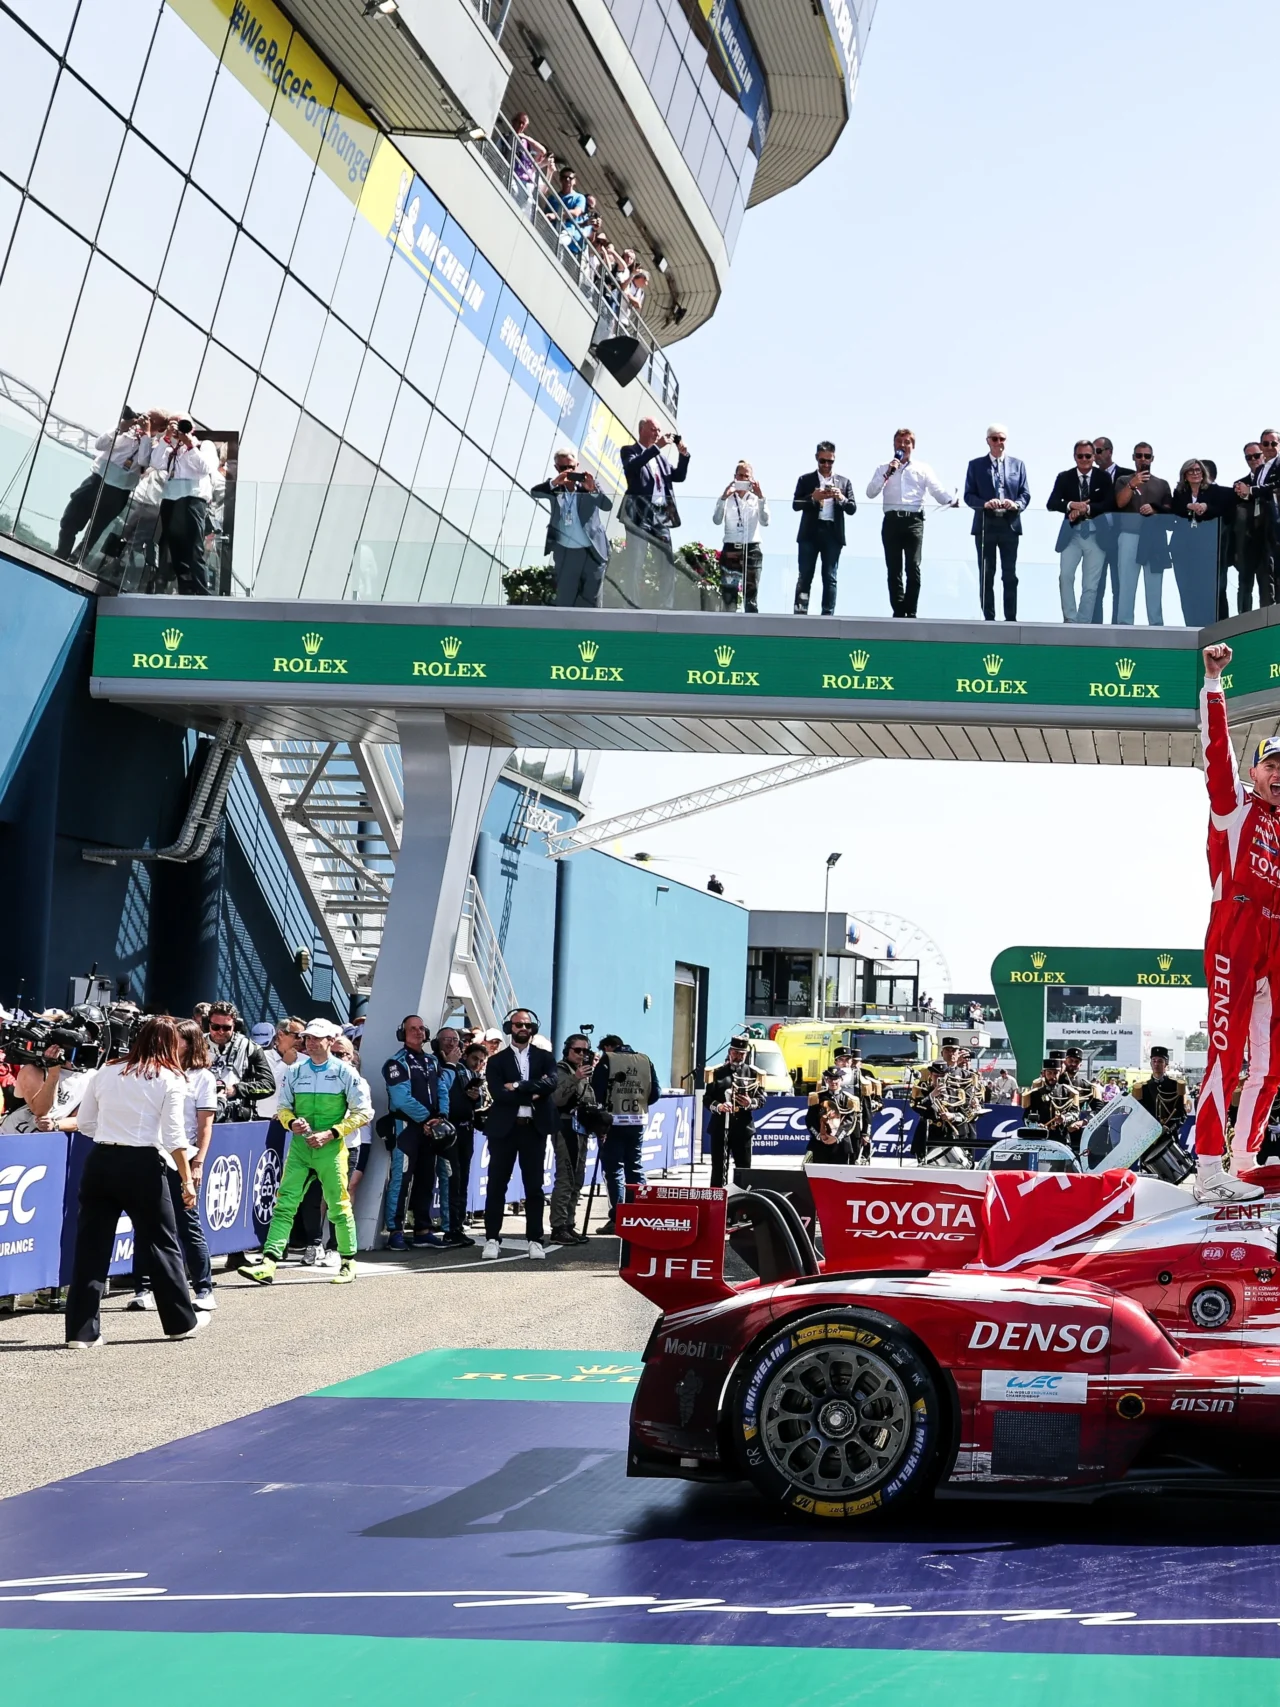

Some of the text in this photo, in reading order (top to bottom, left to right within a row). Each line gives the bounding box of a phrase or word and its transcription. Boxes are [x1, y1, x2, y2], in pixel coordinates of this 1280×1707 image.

[721, 16, 753, 93] MICHELIN
[230, 0, 370, 182] #WeRaceForChange
[417, 224, 485, 312] MICHELIN
[500, 315, 576, 418] #WeRaceForChange
[132, 653, 208, 670] ROLEX
[273, 657, 348, 674] ROLEX
[412, 661, 487, 678] ROLEX
[550, 665, 624, 682] ROLEX
[687, 670, 760, 687] ROLEX
[822, 674, 894, 691] ROLEX
[956, 678, 1028, 695] ROLEX
[1089, 682, 1160, 699] ROLEX
[1010, 971, 1066, 984] ROLEX
[1137, 973, 1192, 986] ROLEX
[1211, 953, 1231, 1051] DENSO
[1062, 1028, 1091, 1037] Experience
[621, 1098, 640, 1112] G8
[846, 1200, 977, 1228] TOYOTA
[1213, 1203, 1266, 1221] ZENT
[621, 1216, 692, 1229] HAYASHI
[845, 1228, 976, 1242] RACING
[1203, 1248, 1223, 1259] FIA
[636, 1257, 714, 1280] JFE
[967, 1321, 1110, 1354] DENSO
[664, 1337, 707, 1358] Mobil
[452, 1372, 641, 1383] ROLE
[745, 1341, 785, 1412] MICHELIN
[1006, 1375, 1063, 1389] WEC
[1170, 1397, 1235, 1413] AISIN
[886, 1427, 926, 1497] MICHELIN
